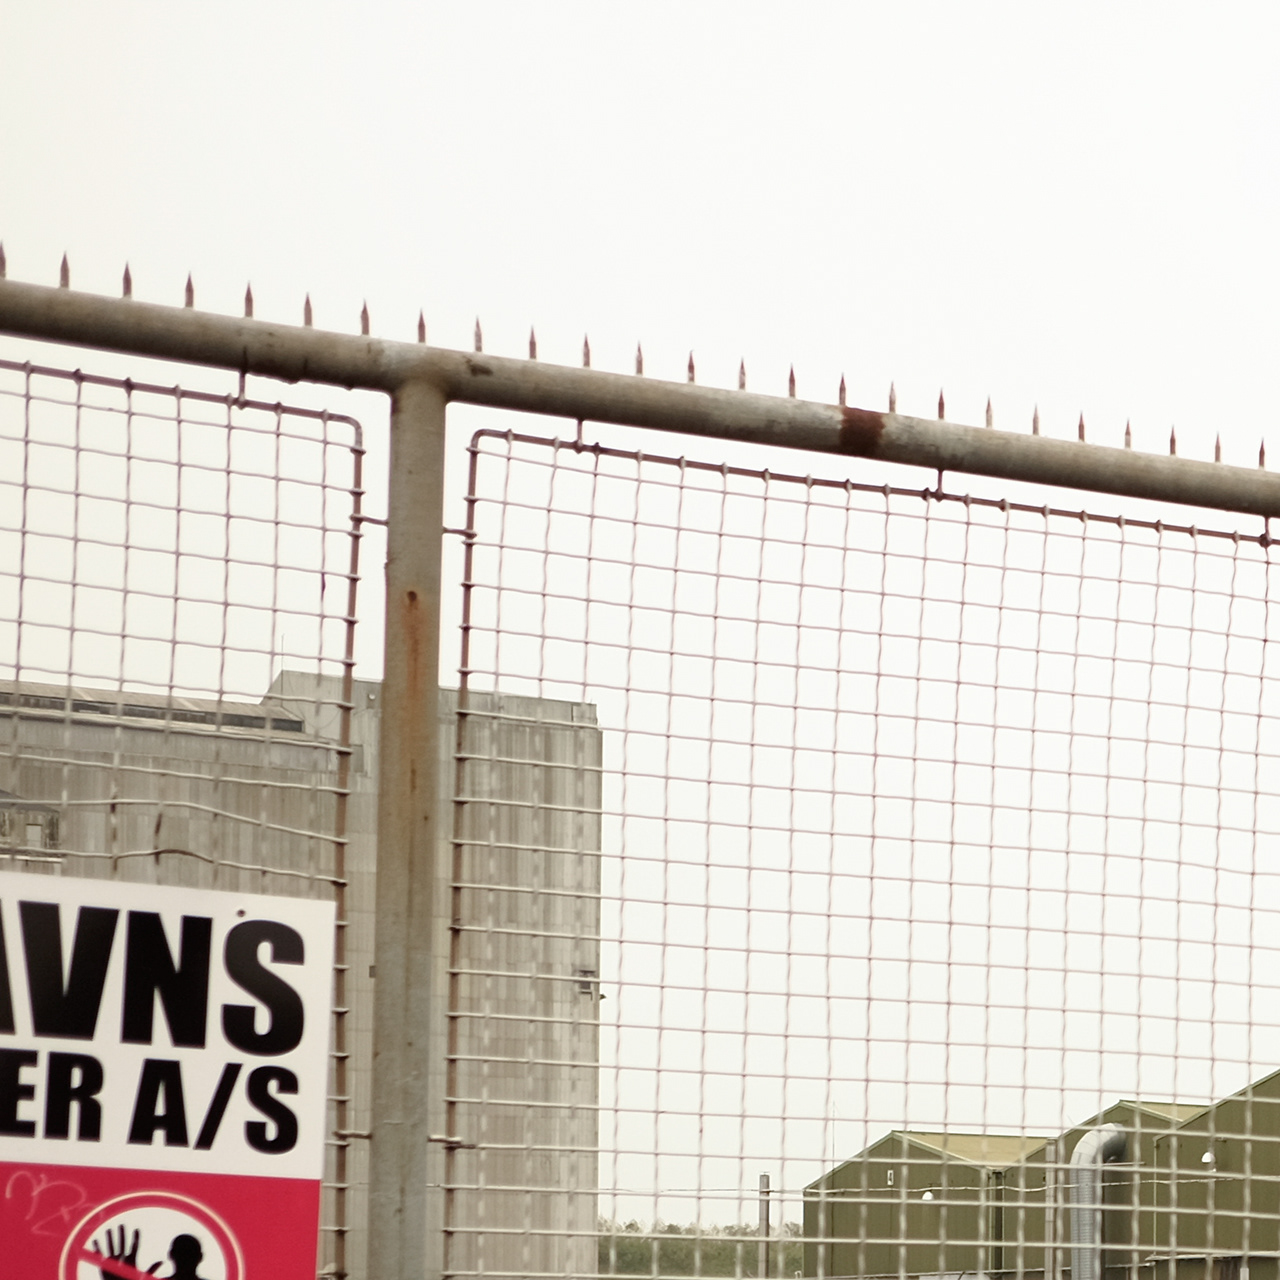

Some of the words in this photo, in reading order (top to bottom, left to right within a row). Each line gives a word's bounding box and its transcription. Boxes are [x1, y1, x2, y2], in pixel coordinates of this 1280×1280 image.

[0, 899, 305, 1058] VNS
[0, 1048, 104, 1144] ER
[127, 1058, 299, 1155] A/S
